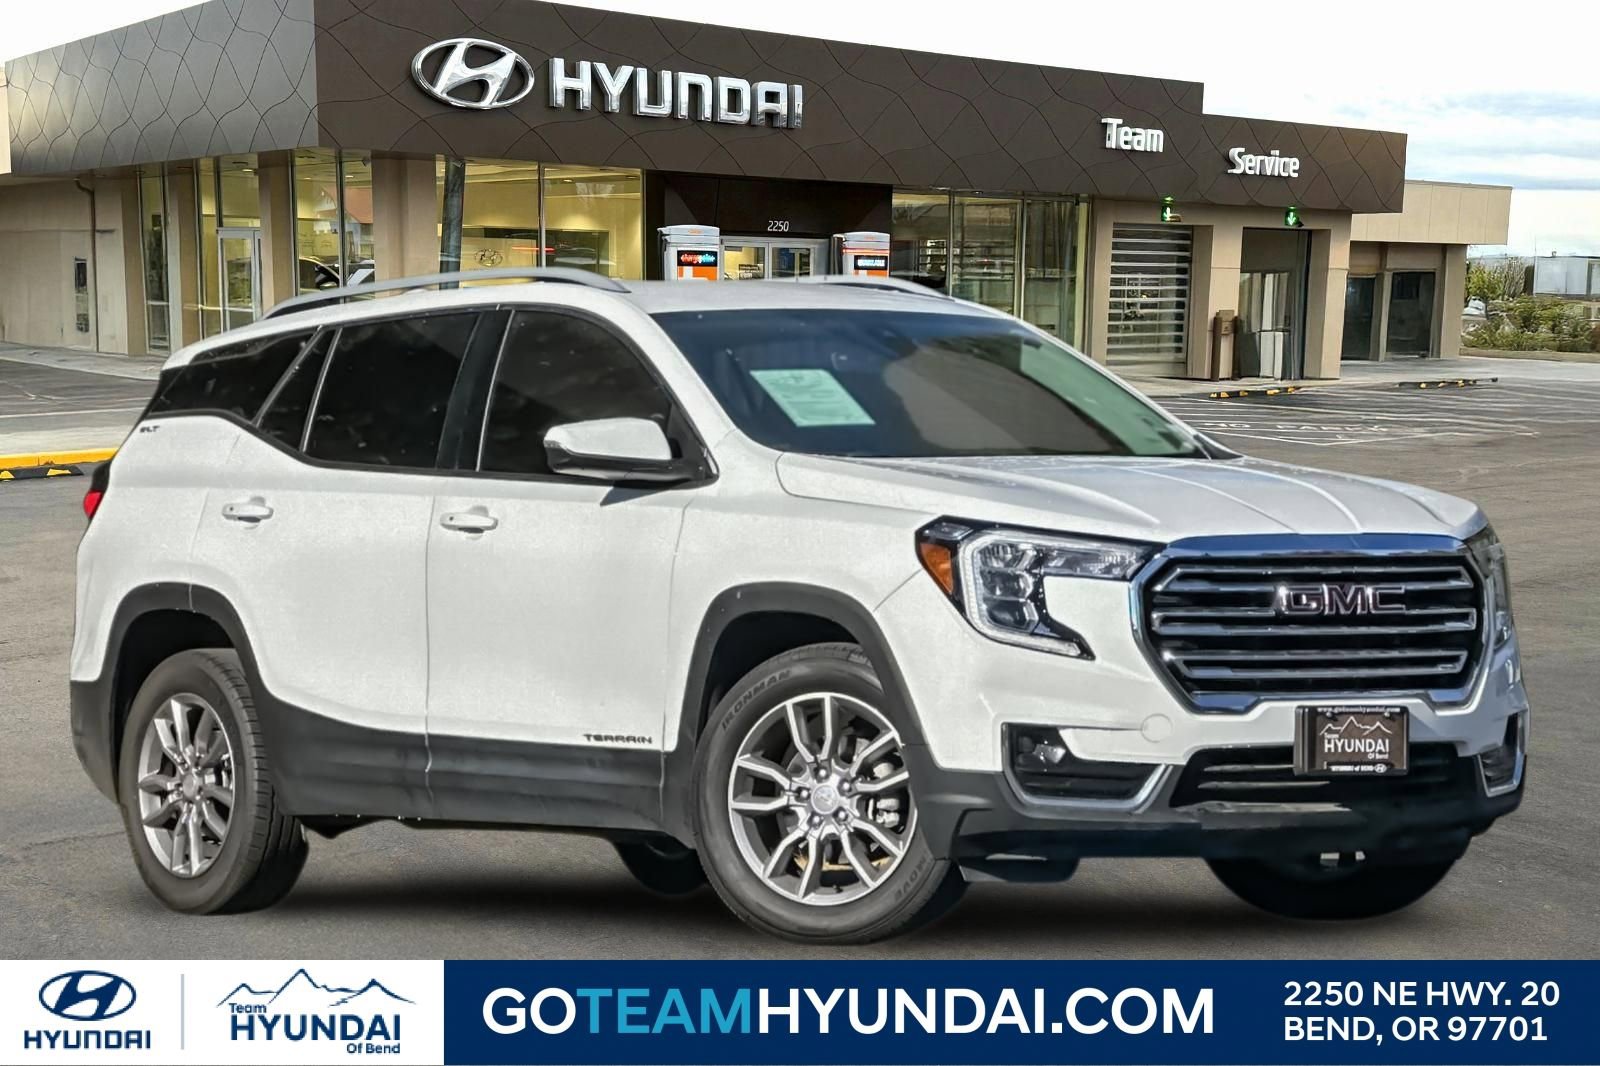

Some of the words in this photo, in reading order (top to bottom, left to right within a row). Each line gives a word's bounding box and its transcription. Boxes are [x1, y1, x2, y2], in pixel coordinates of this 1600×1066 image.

[548, 57, 803, 129] HYUNDAI
[1101, 117, 1164, 153] Team
[1227, 147, 1300, 178] Service
[767, 220, 790, 232] 2250
[1276, 583, 1406, 615] GMC
[722, 669, 792, 732] IRONMAN
[583, 733, 653, 744] TERRAIN
[1324, 738, 1389, 753] HYUNDAI
